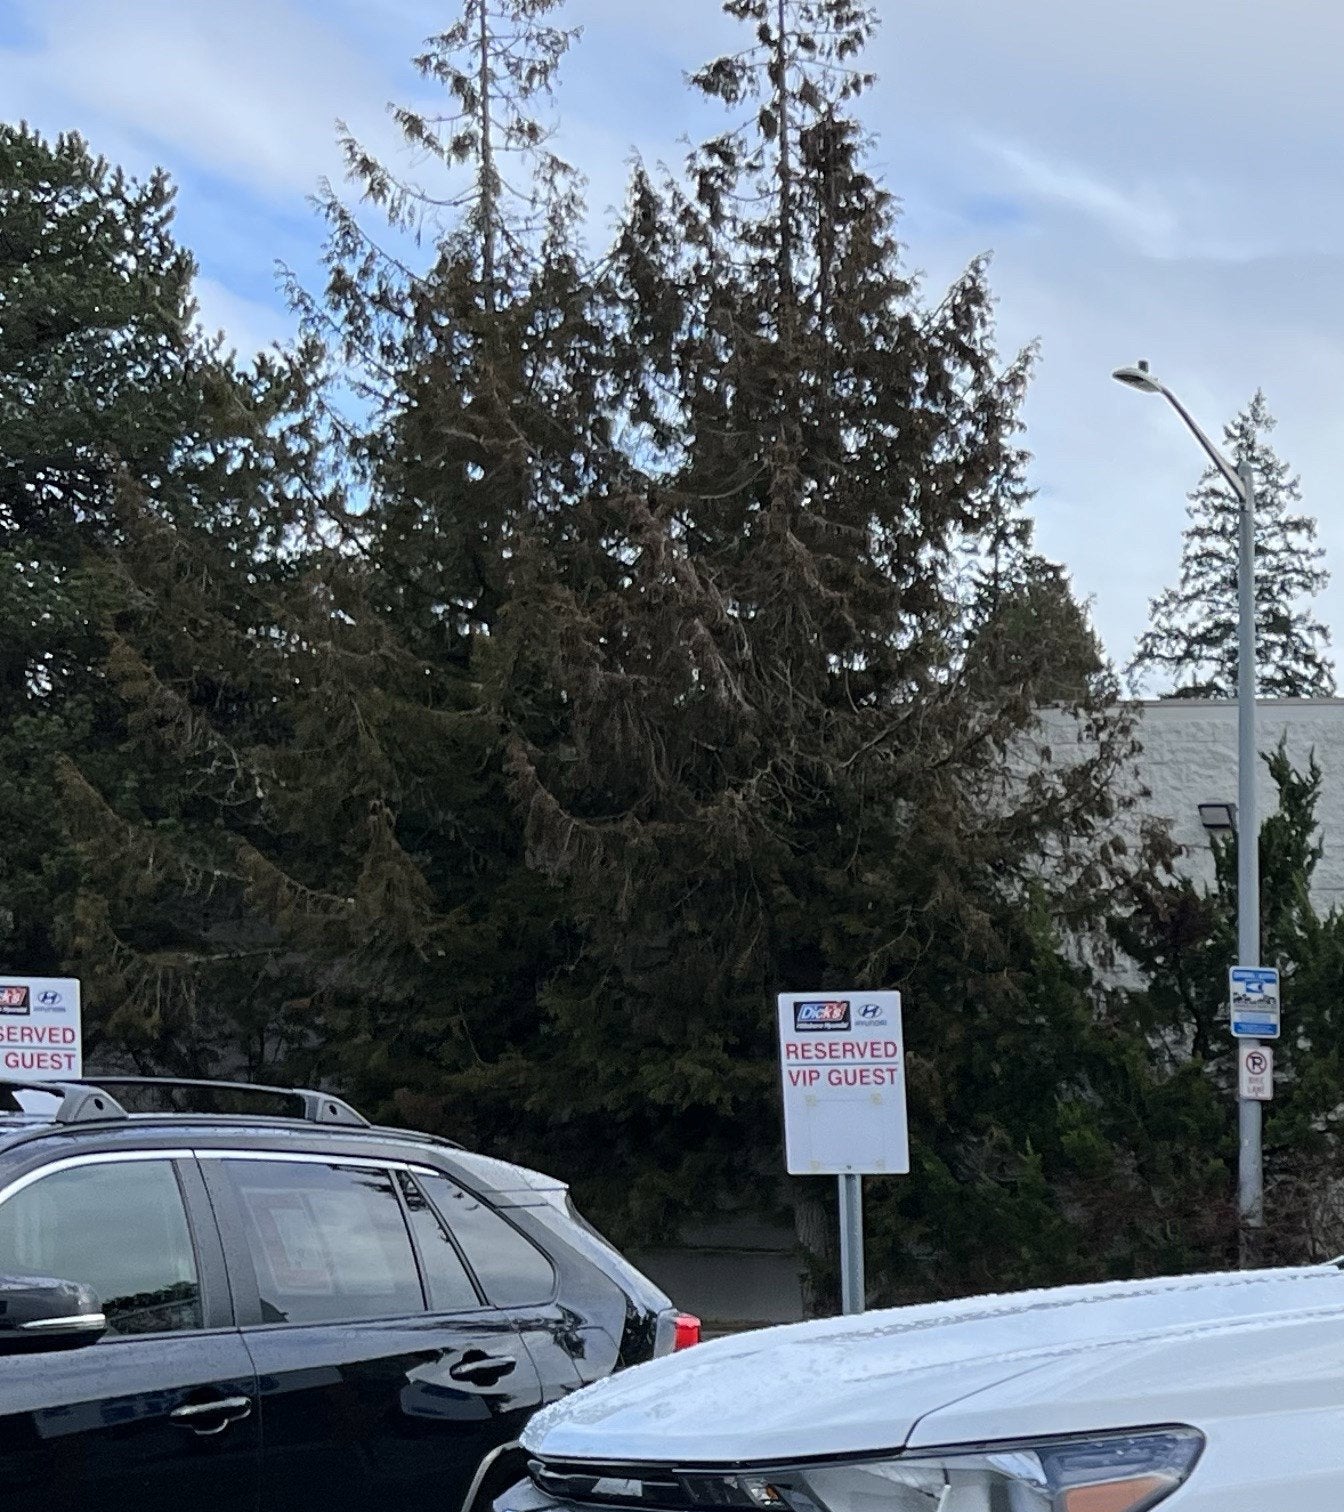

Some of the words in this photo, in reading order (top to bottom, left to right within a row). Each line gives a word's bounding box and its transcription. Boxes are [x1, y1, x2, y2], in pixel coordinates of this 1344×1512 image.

[785, 1041, 898, 1060] RESERVED
[5, 1051, 76, 1071] GUEST
[788, 1069, 820, 1086] VIP
[827, 1067, 897, 1086] GUEST
